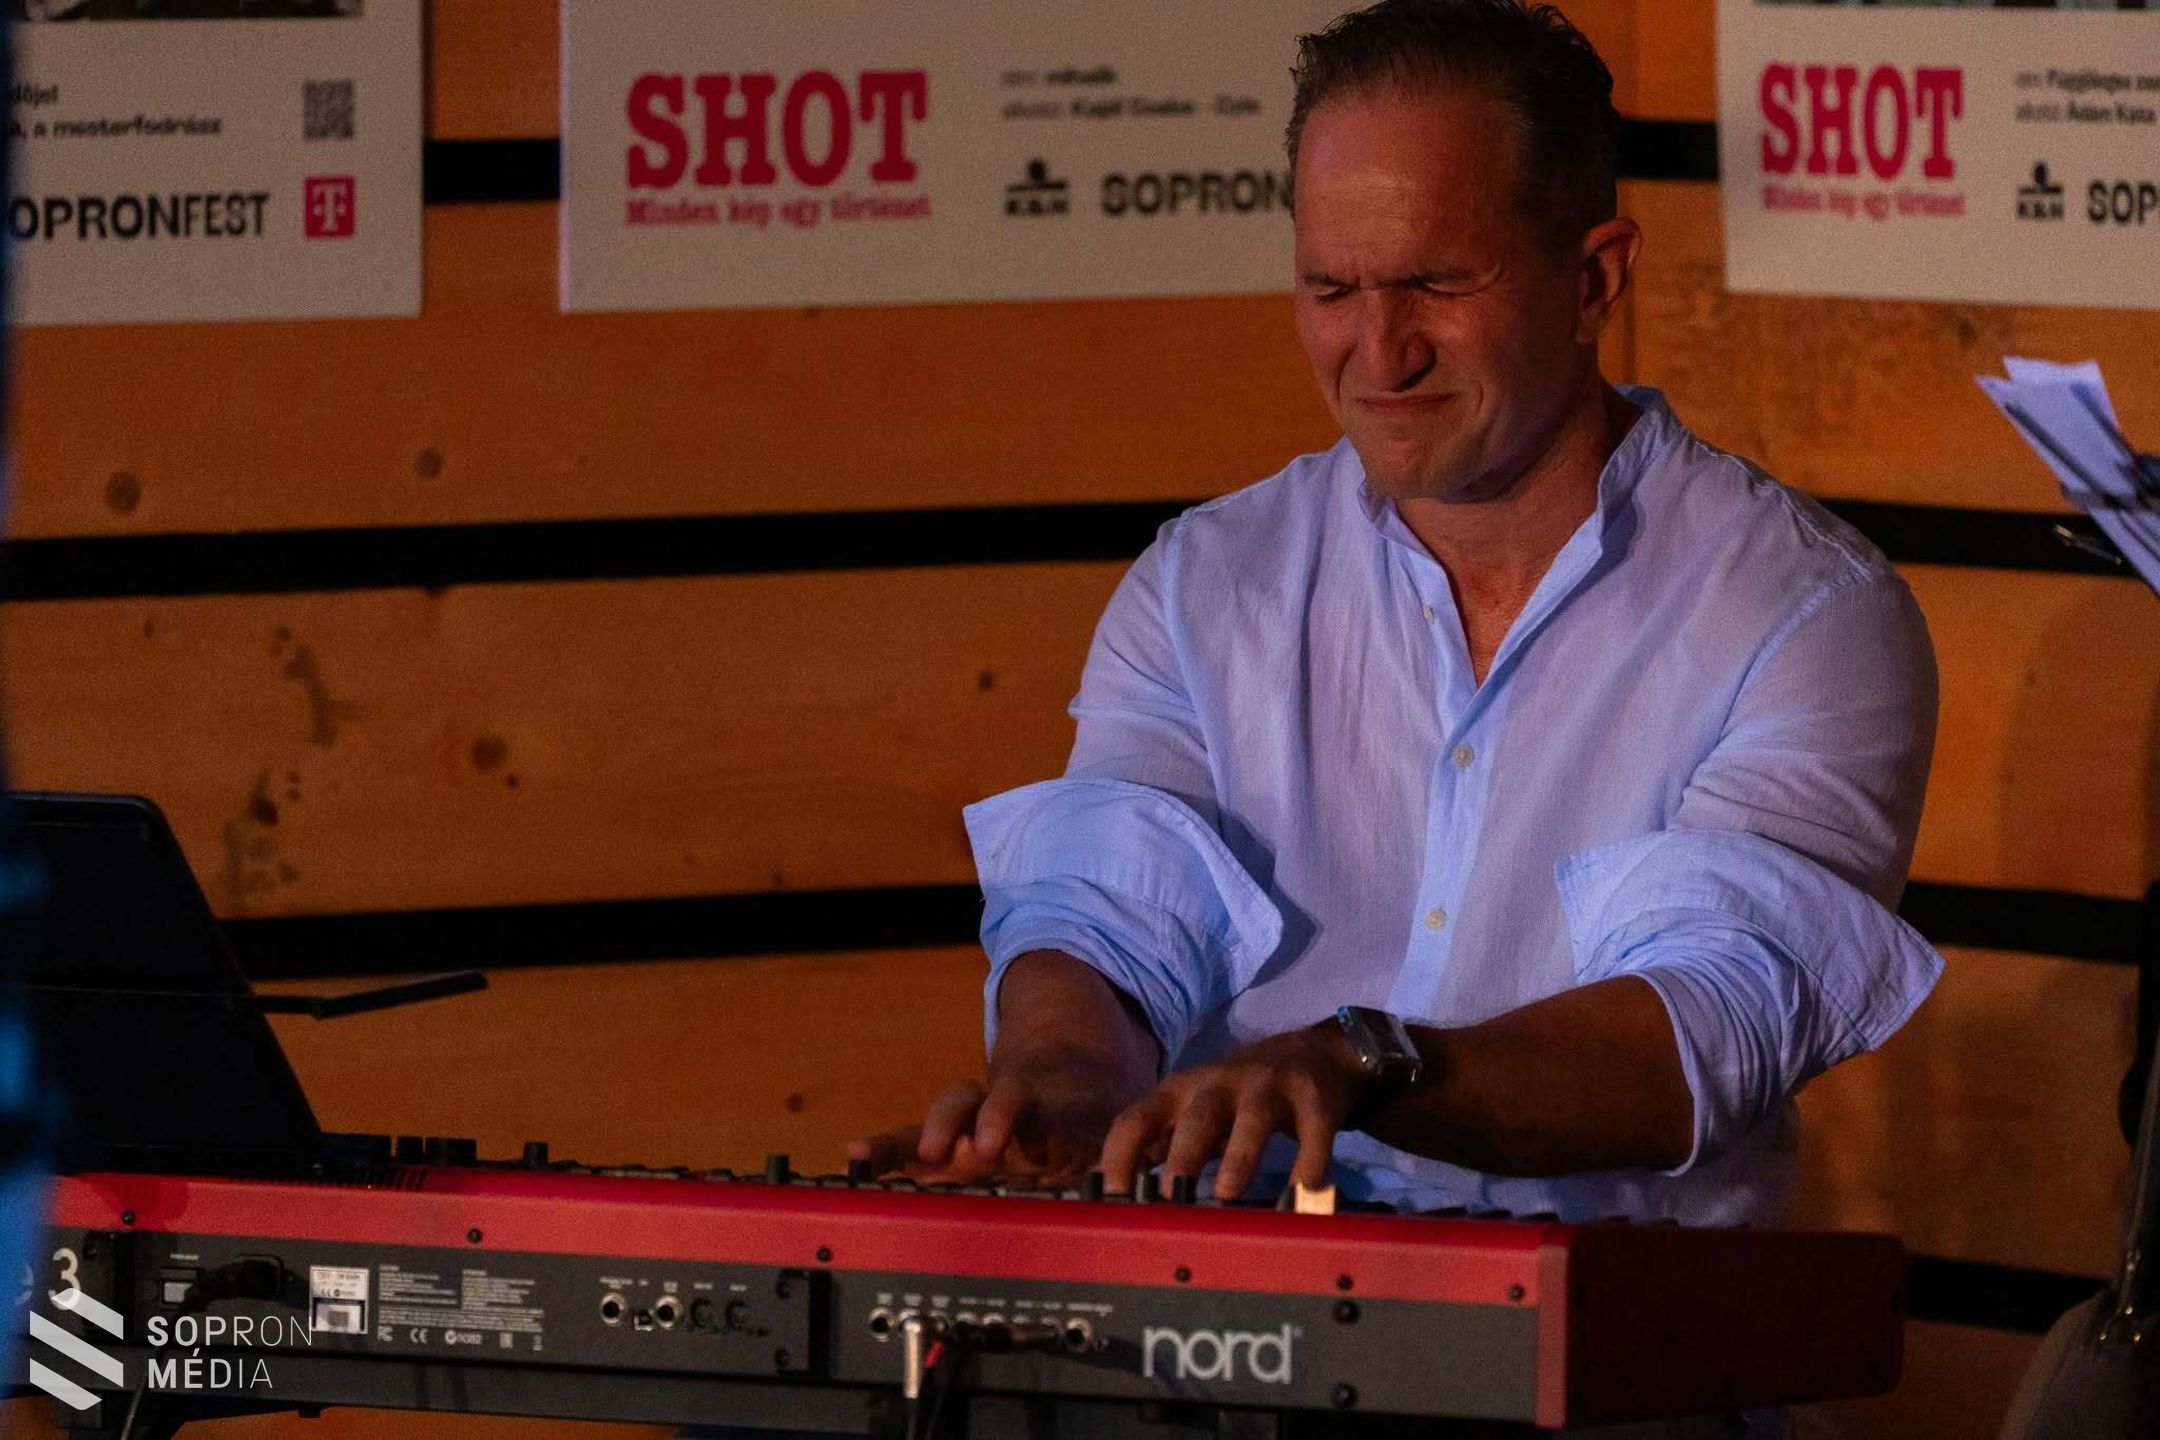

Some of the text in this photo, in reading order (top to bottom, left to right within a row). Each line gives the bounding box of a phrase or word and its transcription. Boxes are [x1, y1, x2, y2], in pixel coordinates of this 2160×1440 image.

[625, 70, 929, 190] SHOT
[1759, 61, 1964, 181] SHOT
[48, 1247, 81, 1311] 3
[1142, 1323, 1293, 1385] nord
